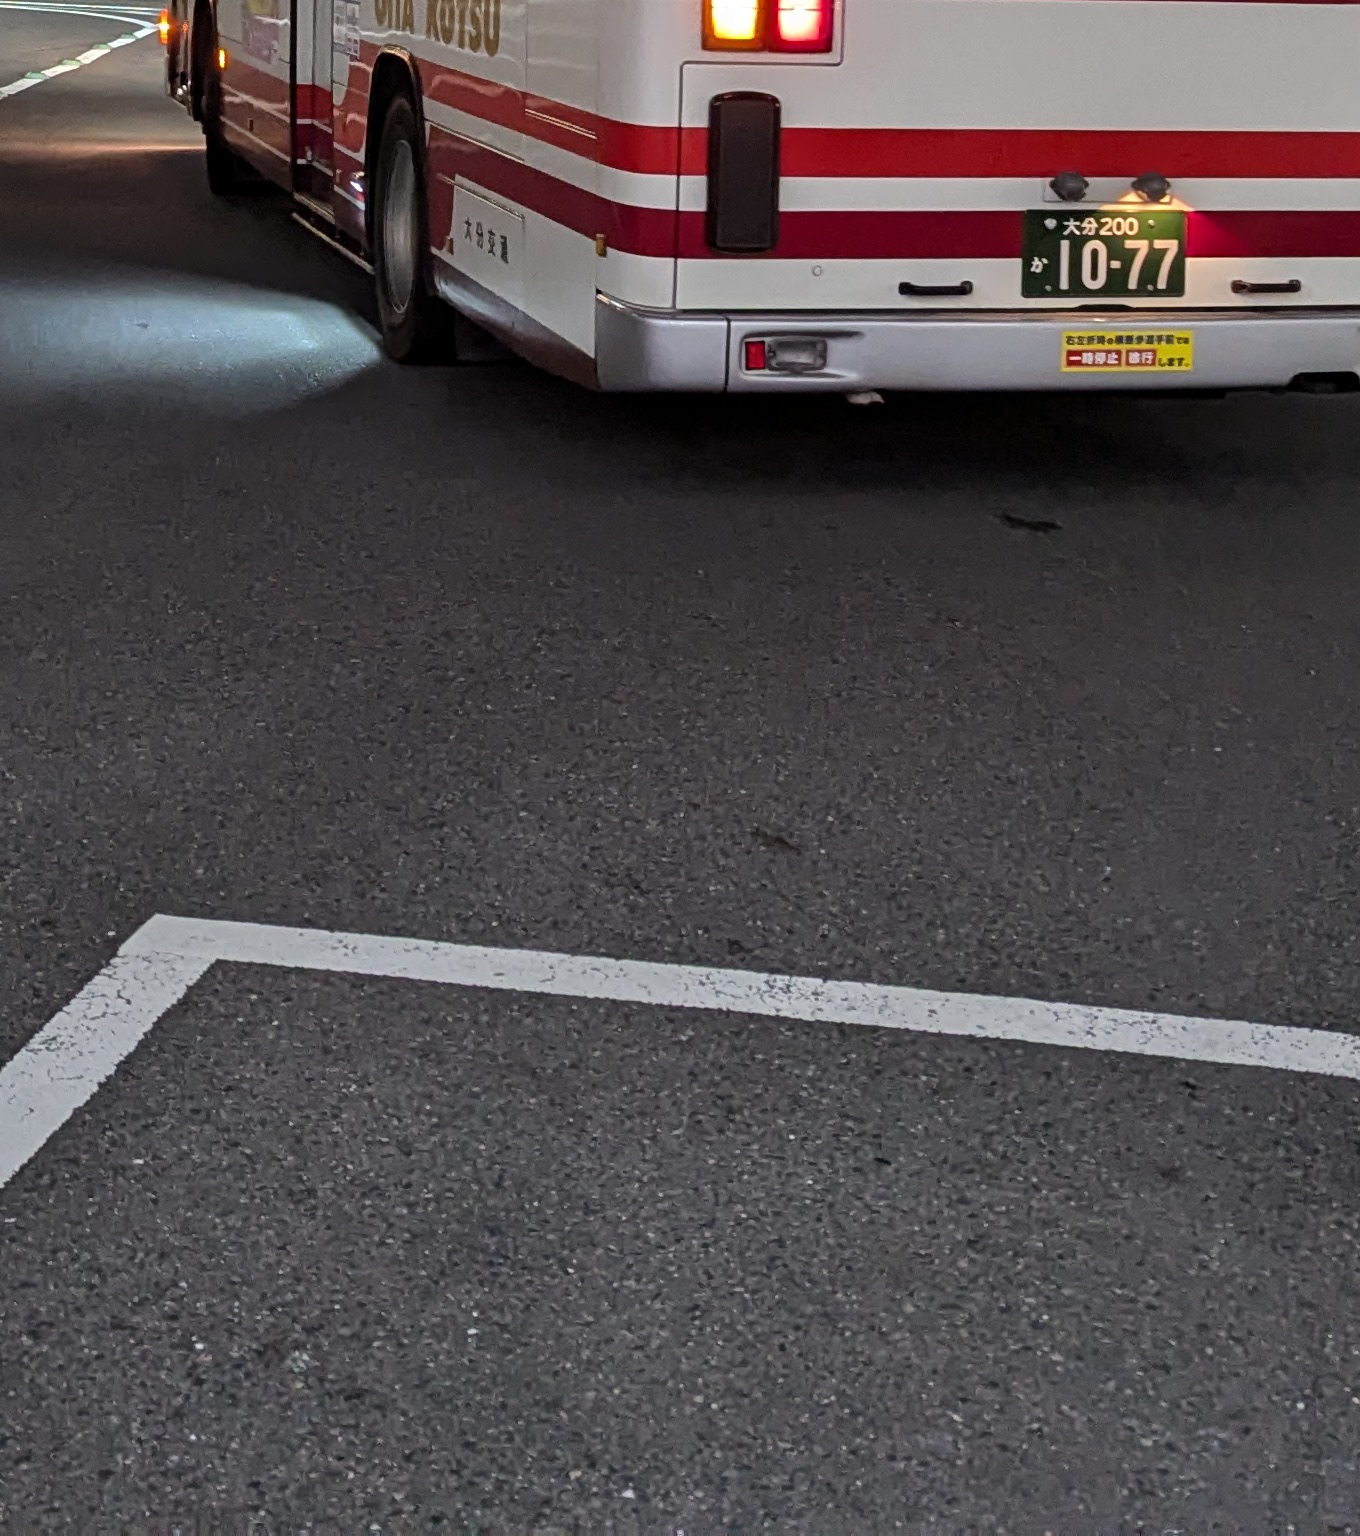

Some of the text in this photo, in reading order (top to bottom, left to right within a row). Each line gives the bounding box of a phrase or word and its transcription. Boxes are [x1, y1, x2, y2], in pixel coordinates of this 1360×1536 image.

[463, 216, 510, 264] 大分交通
[1059, 239, 1179, 290] 10-77
[1068, 351, 1119, 364] 一時停止
